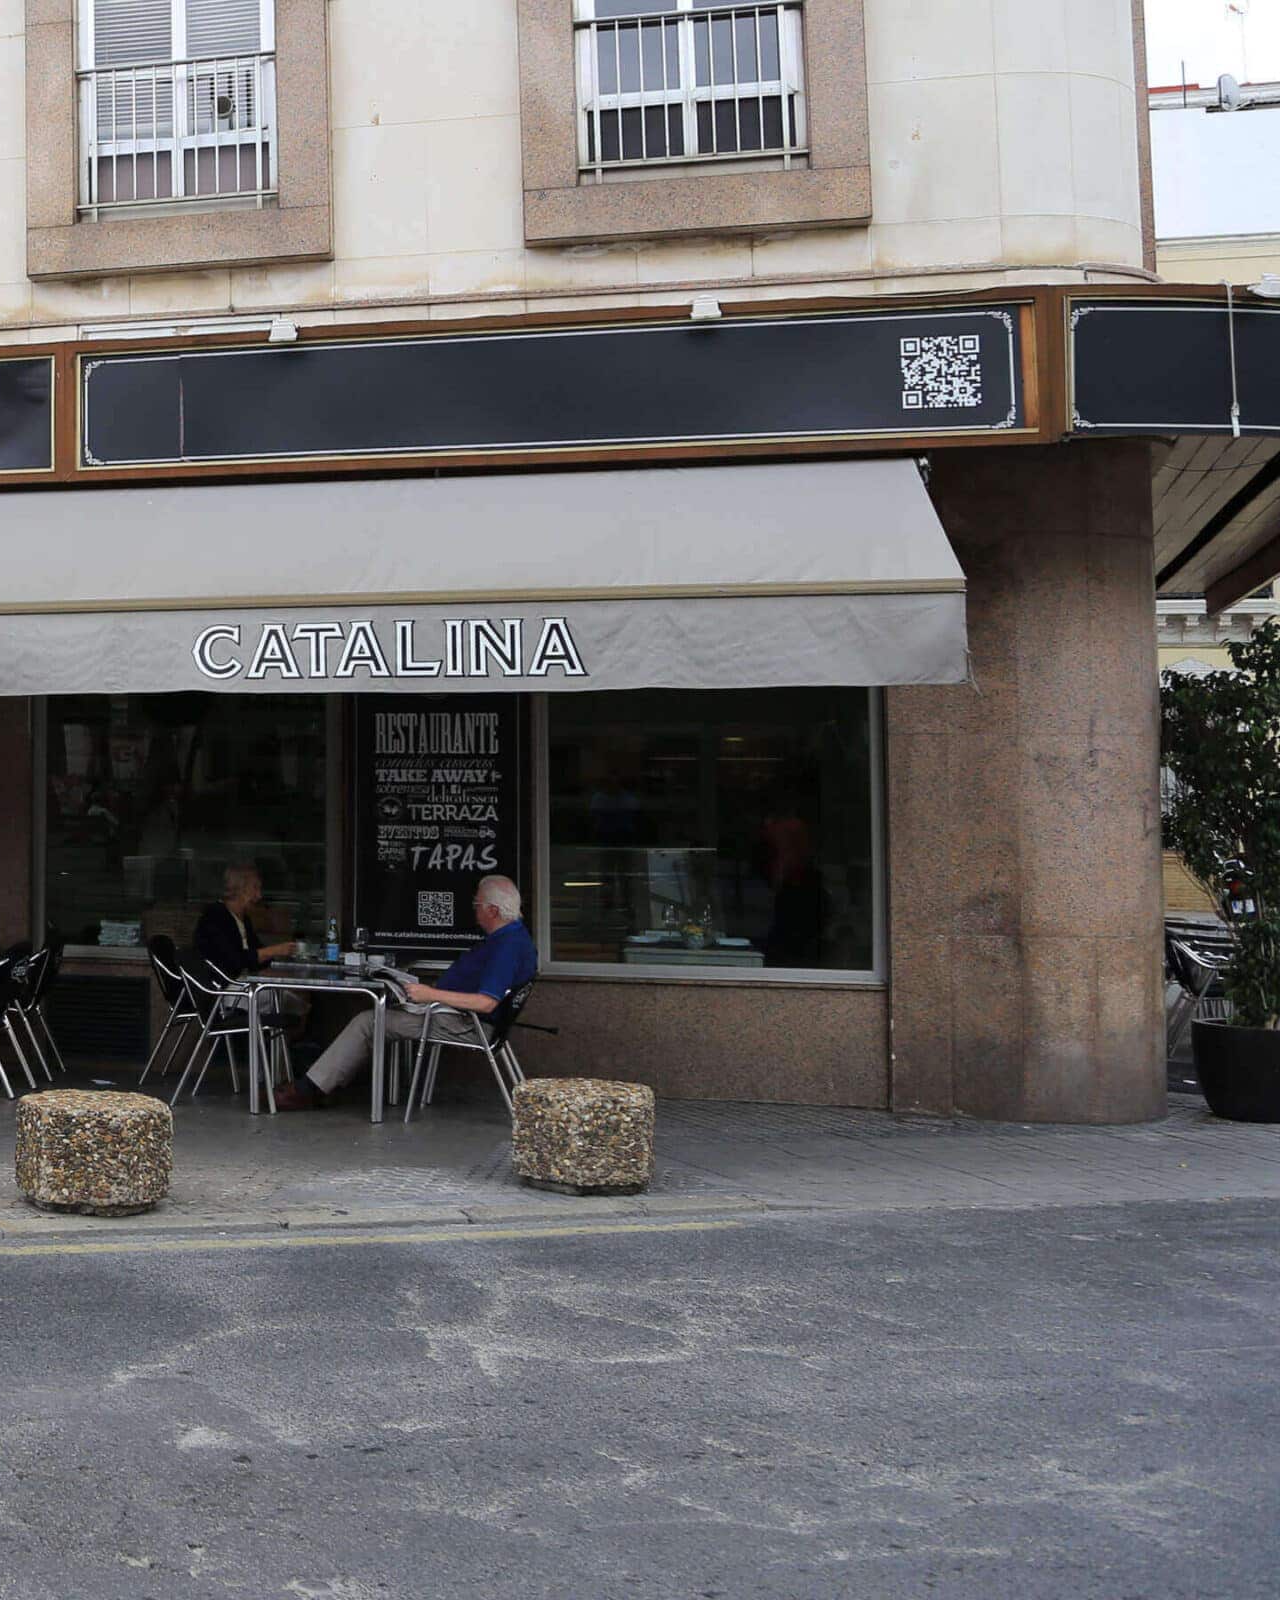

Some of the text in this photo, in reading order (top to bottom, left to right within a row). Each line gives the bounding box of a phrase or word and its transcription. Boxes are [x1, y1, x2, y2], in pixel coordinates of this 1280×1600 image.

[191, 616, 590, 679] CATALINA
[375, 712, 500, 754] RESTAURANTE
[375, 769, 488, 783] TAKE AWAY
[407, 804, 499, 821] TERRAZA
[377, 825, 439, 839] EVENTOS
[411, 843, 498, 871] TAPAS
